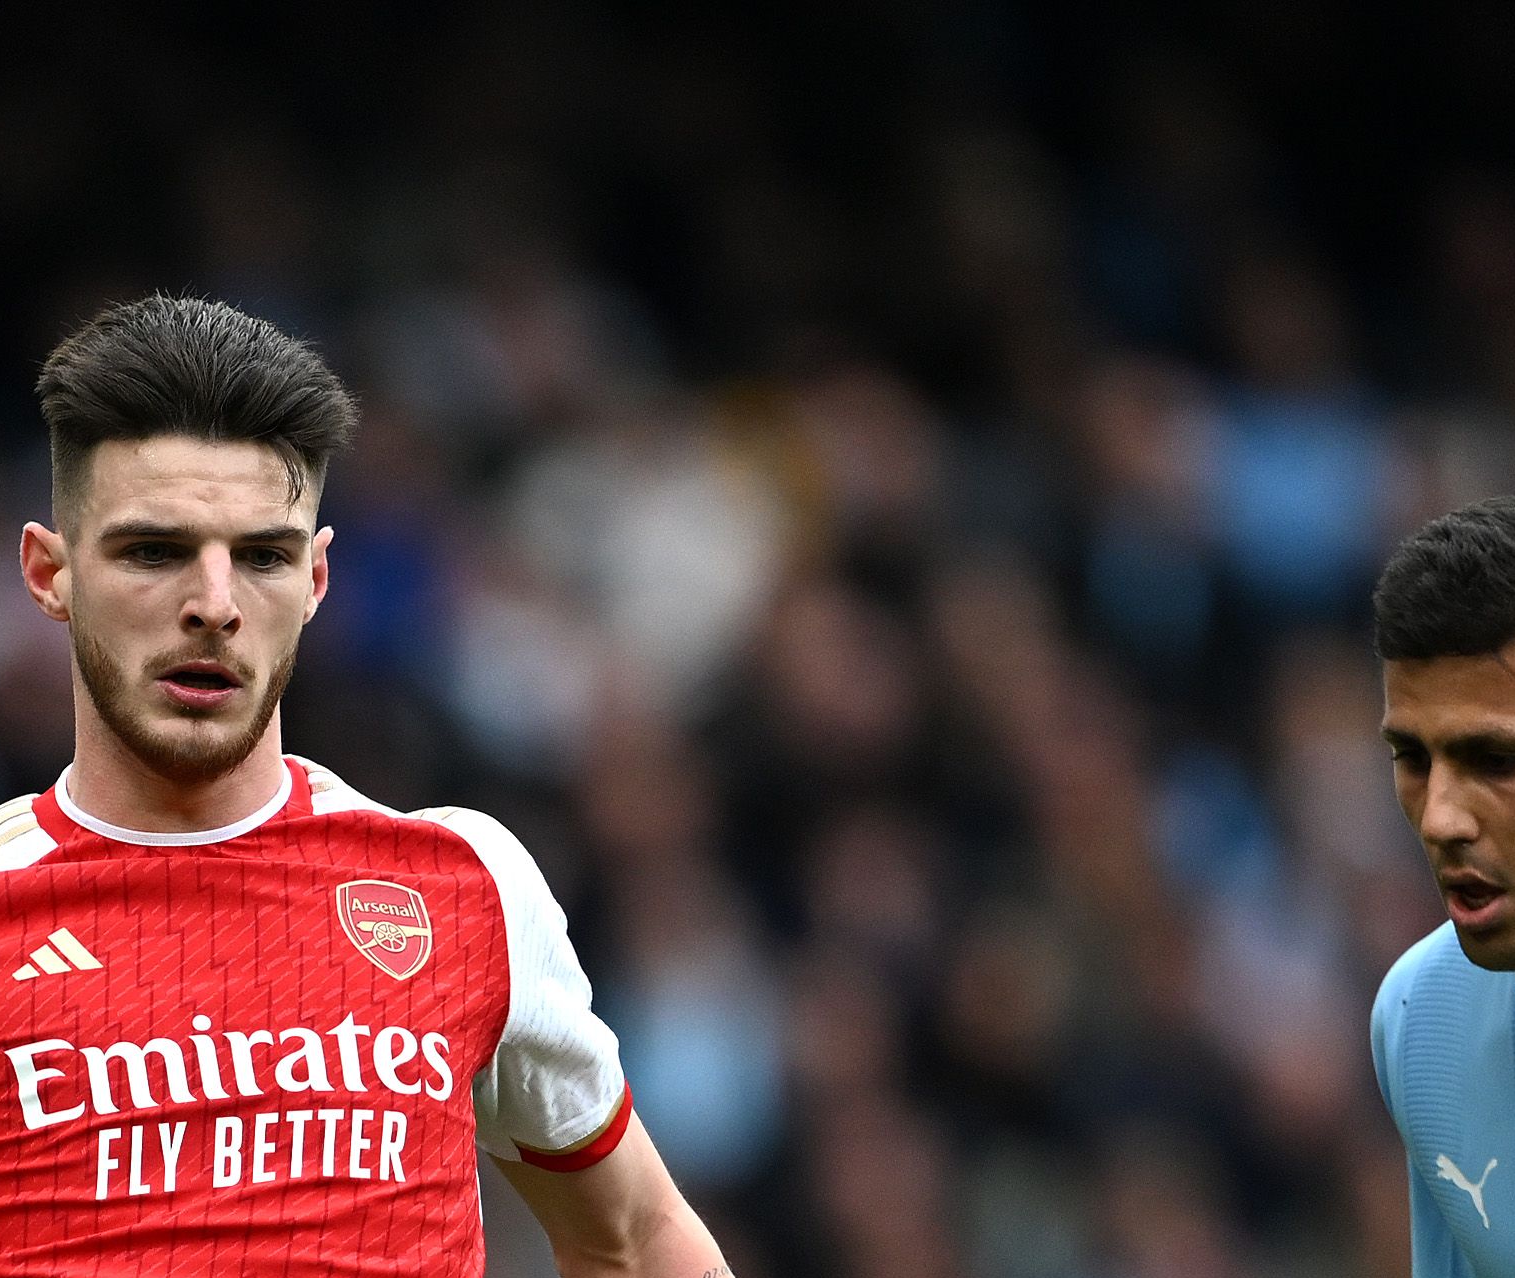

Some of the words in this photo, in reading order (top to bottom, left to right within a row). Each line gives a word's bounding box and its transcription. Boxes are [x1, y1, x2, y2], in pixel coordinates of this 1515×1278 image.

[351, 898, 416, 918] Arsenal
[4, 1011, 454, 1130] Emirates
[95, 1121, 187, 1200] FLY
[212, 1109, 408, 1190] BETTER
